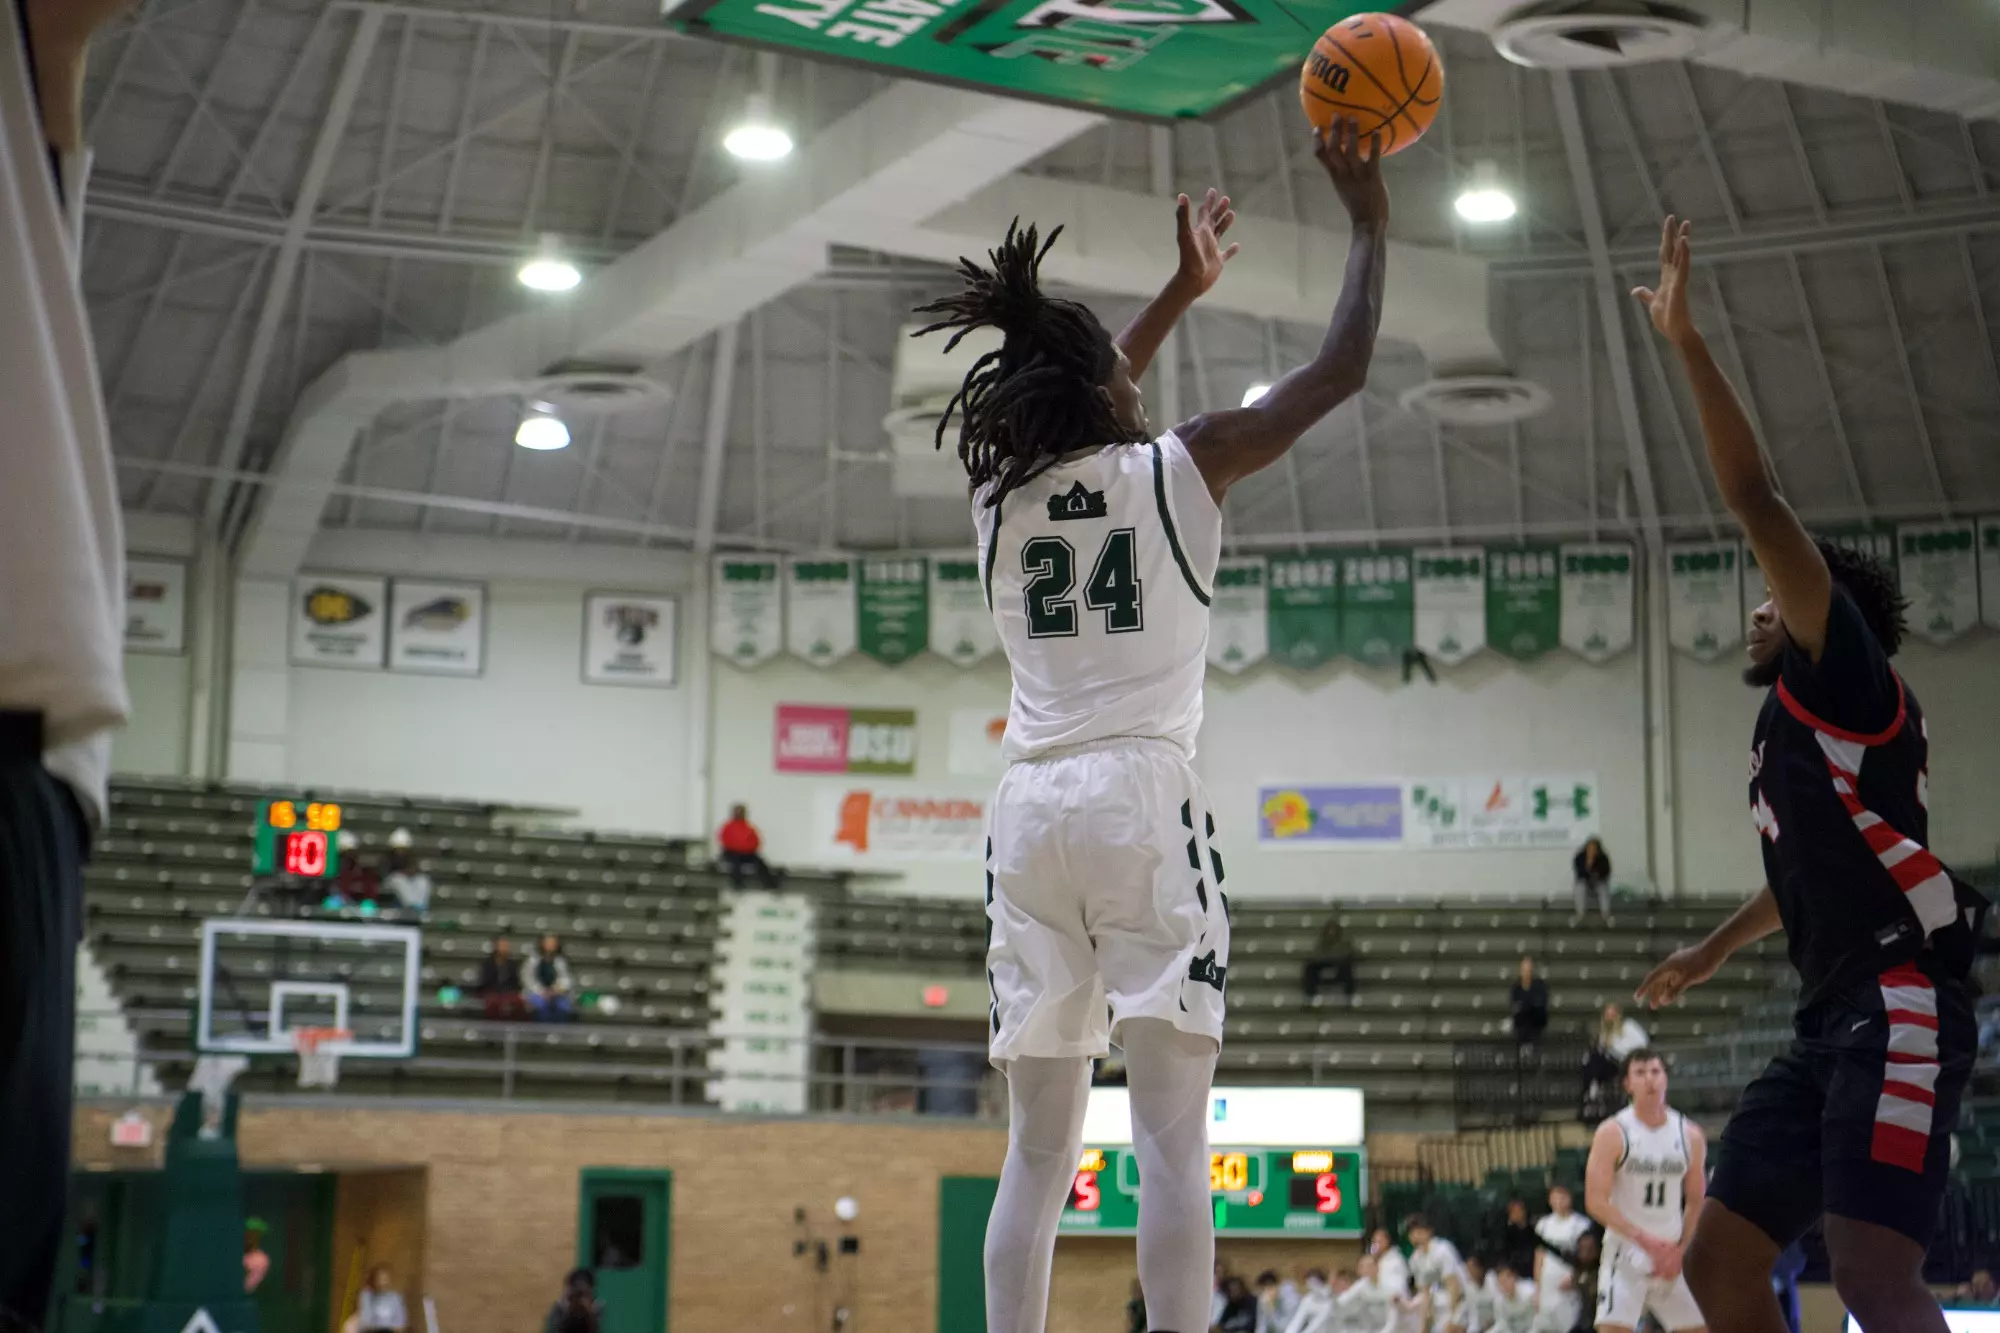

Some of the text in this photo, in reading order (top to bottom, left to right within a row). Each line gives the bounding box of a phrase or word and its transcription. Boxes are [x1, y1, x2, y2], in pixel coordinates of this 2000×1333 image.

[824, 0, 961, 48] ATE
[1020, 526, 1144, 640] 24
[1074, 1171, 1101, 1211] 5
[1315, 1172, 1341, 1213] 5
[1642, 1180, 1667, 1208] 11
